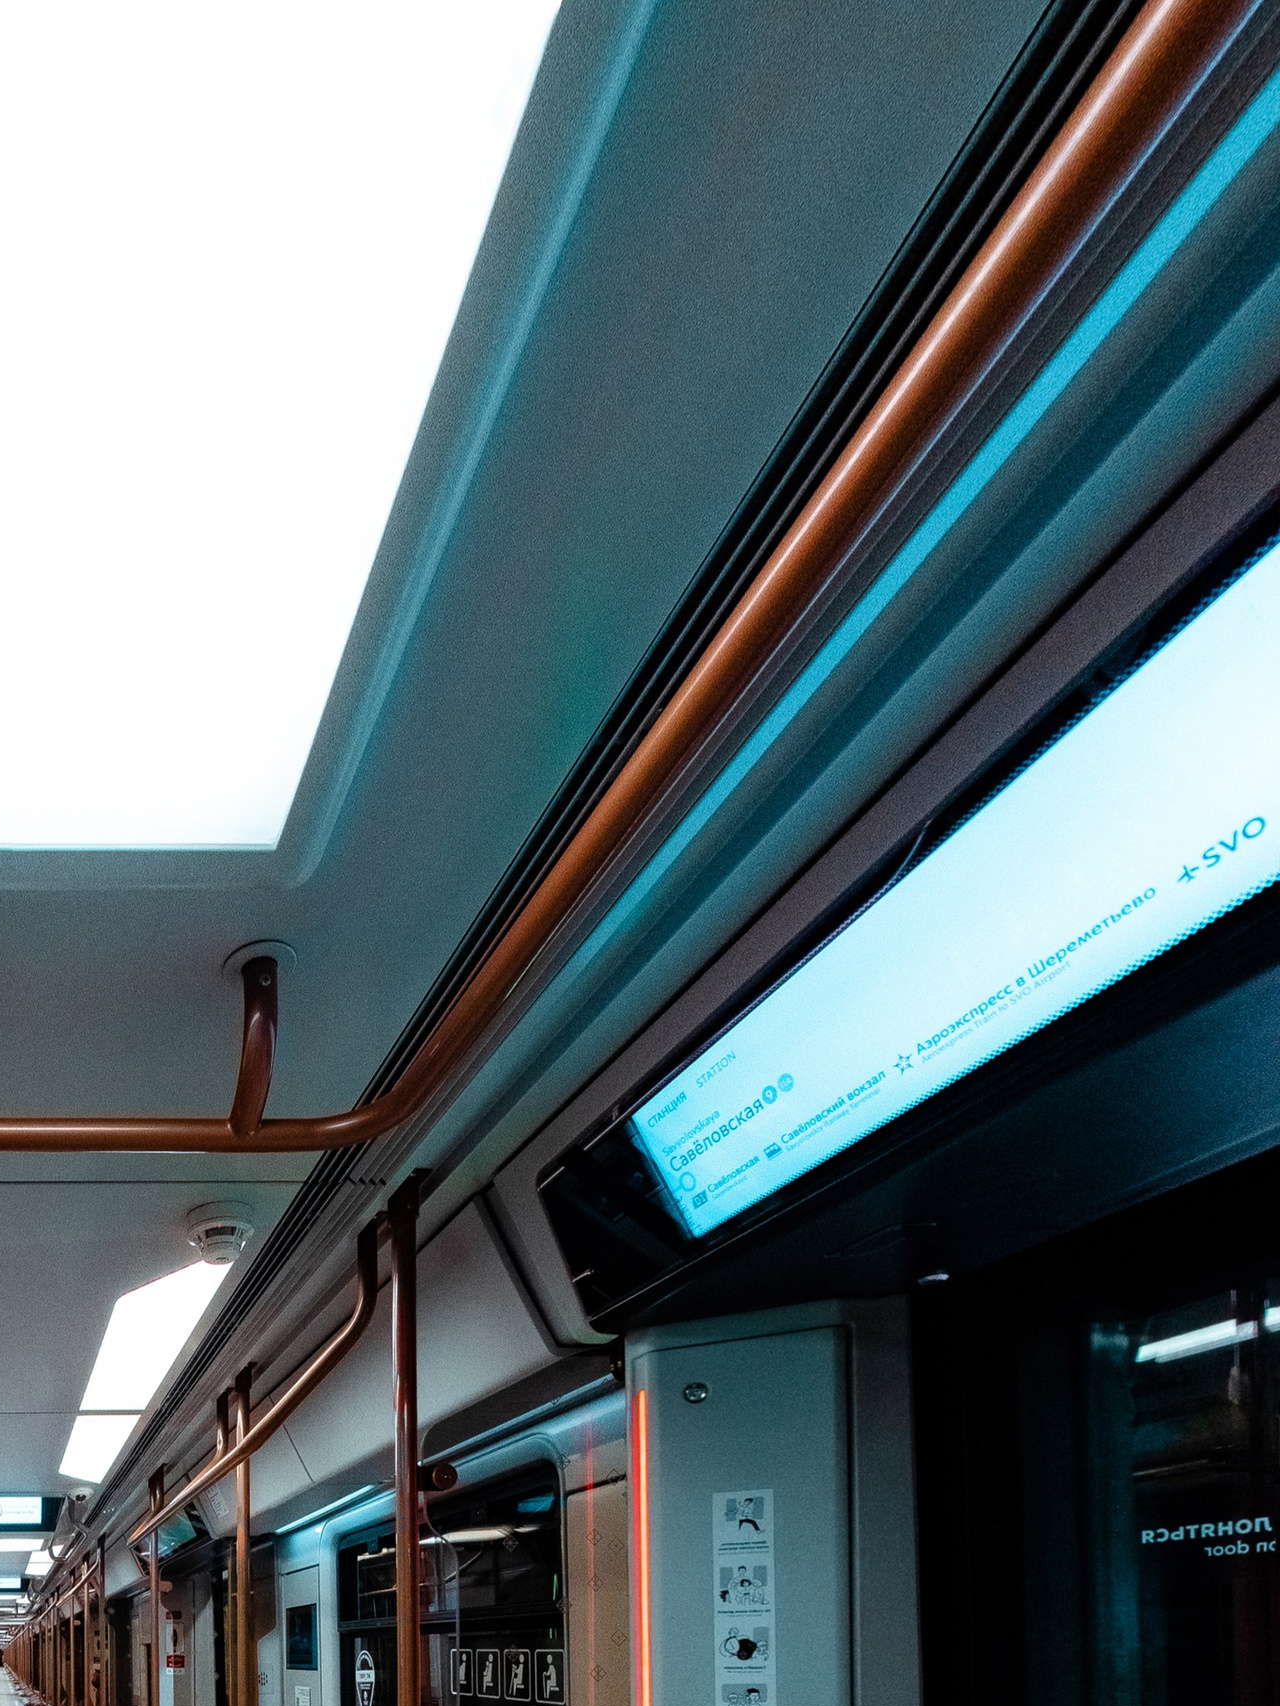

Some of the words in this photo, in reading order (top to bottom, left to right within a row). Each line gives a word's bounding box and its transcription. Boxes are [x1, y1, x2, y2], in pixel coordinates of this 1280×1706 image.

[1202, 817, 1266, 868] SVO
[917, 984, 1014, 1053] Аэроэкспресс
[1016, 976, 1026, 987] в
[1027, 887, 1157, 979] Шереметьево
[696, 1051, 736, 1088] STATION
[648, 1091, 687, 1127] СТАНЦИЯ
[781, 1097, 845, 1144] Савёловский
[848, 1070, 886, 1101] вокзал
[670, 1098, 764, 1172] Савёловская
[708, 1155, 760, 1193] Савёловская
